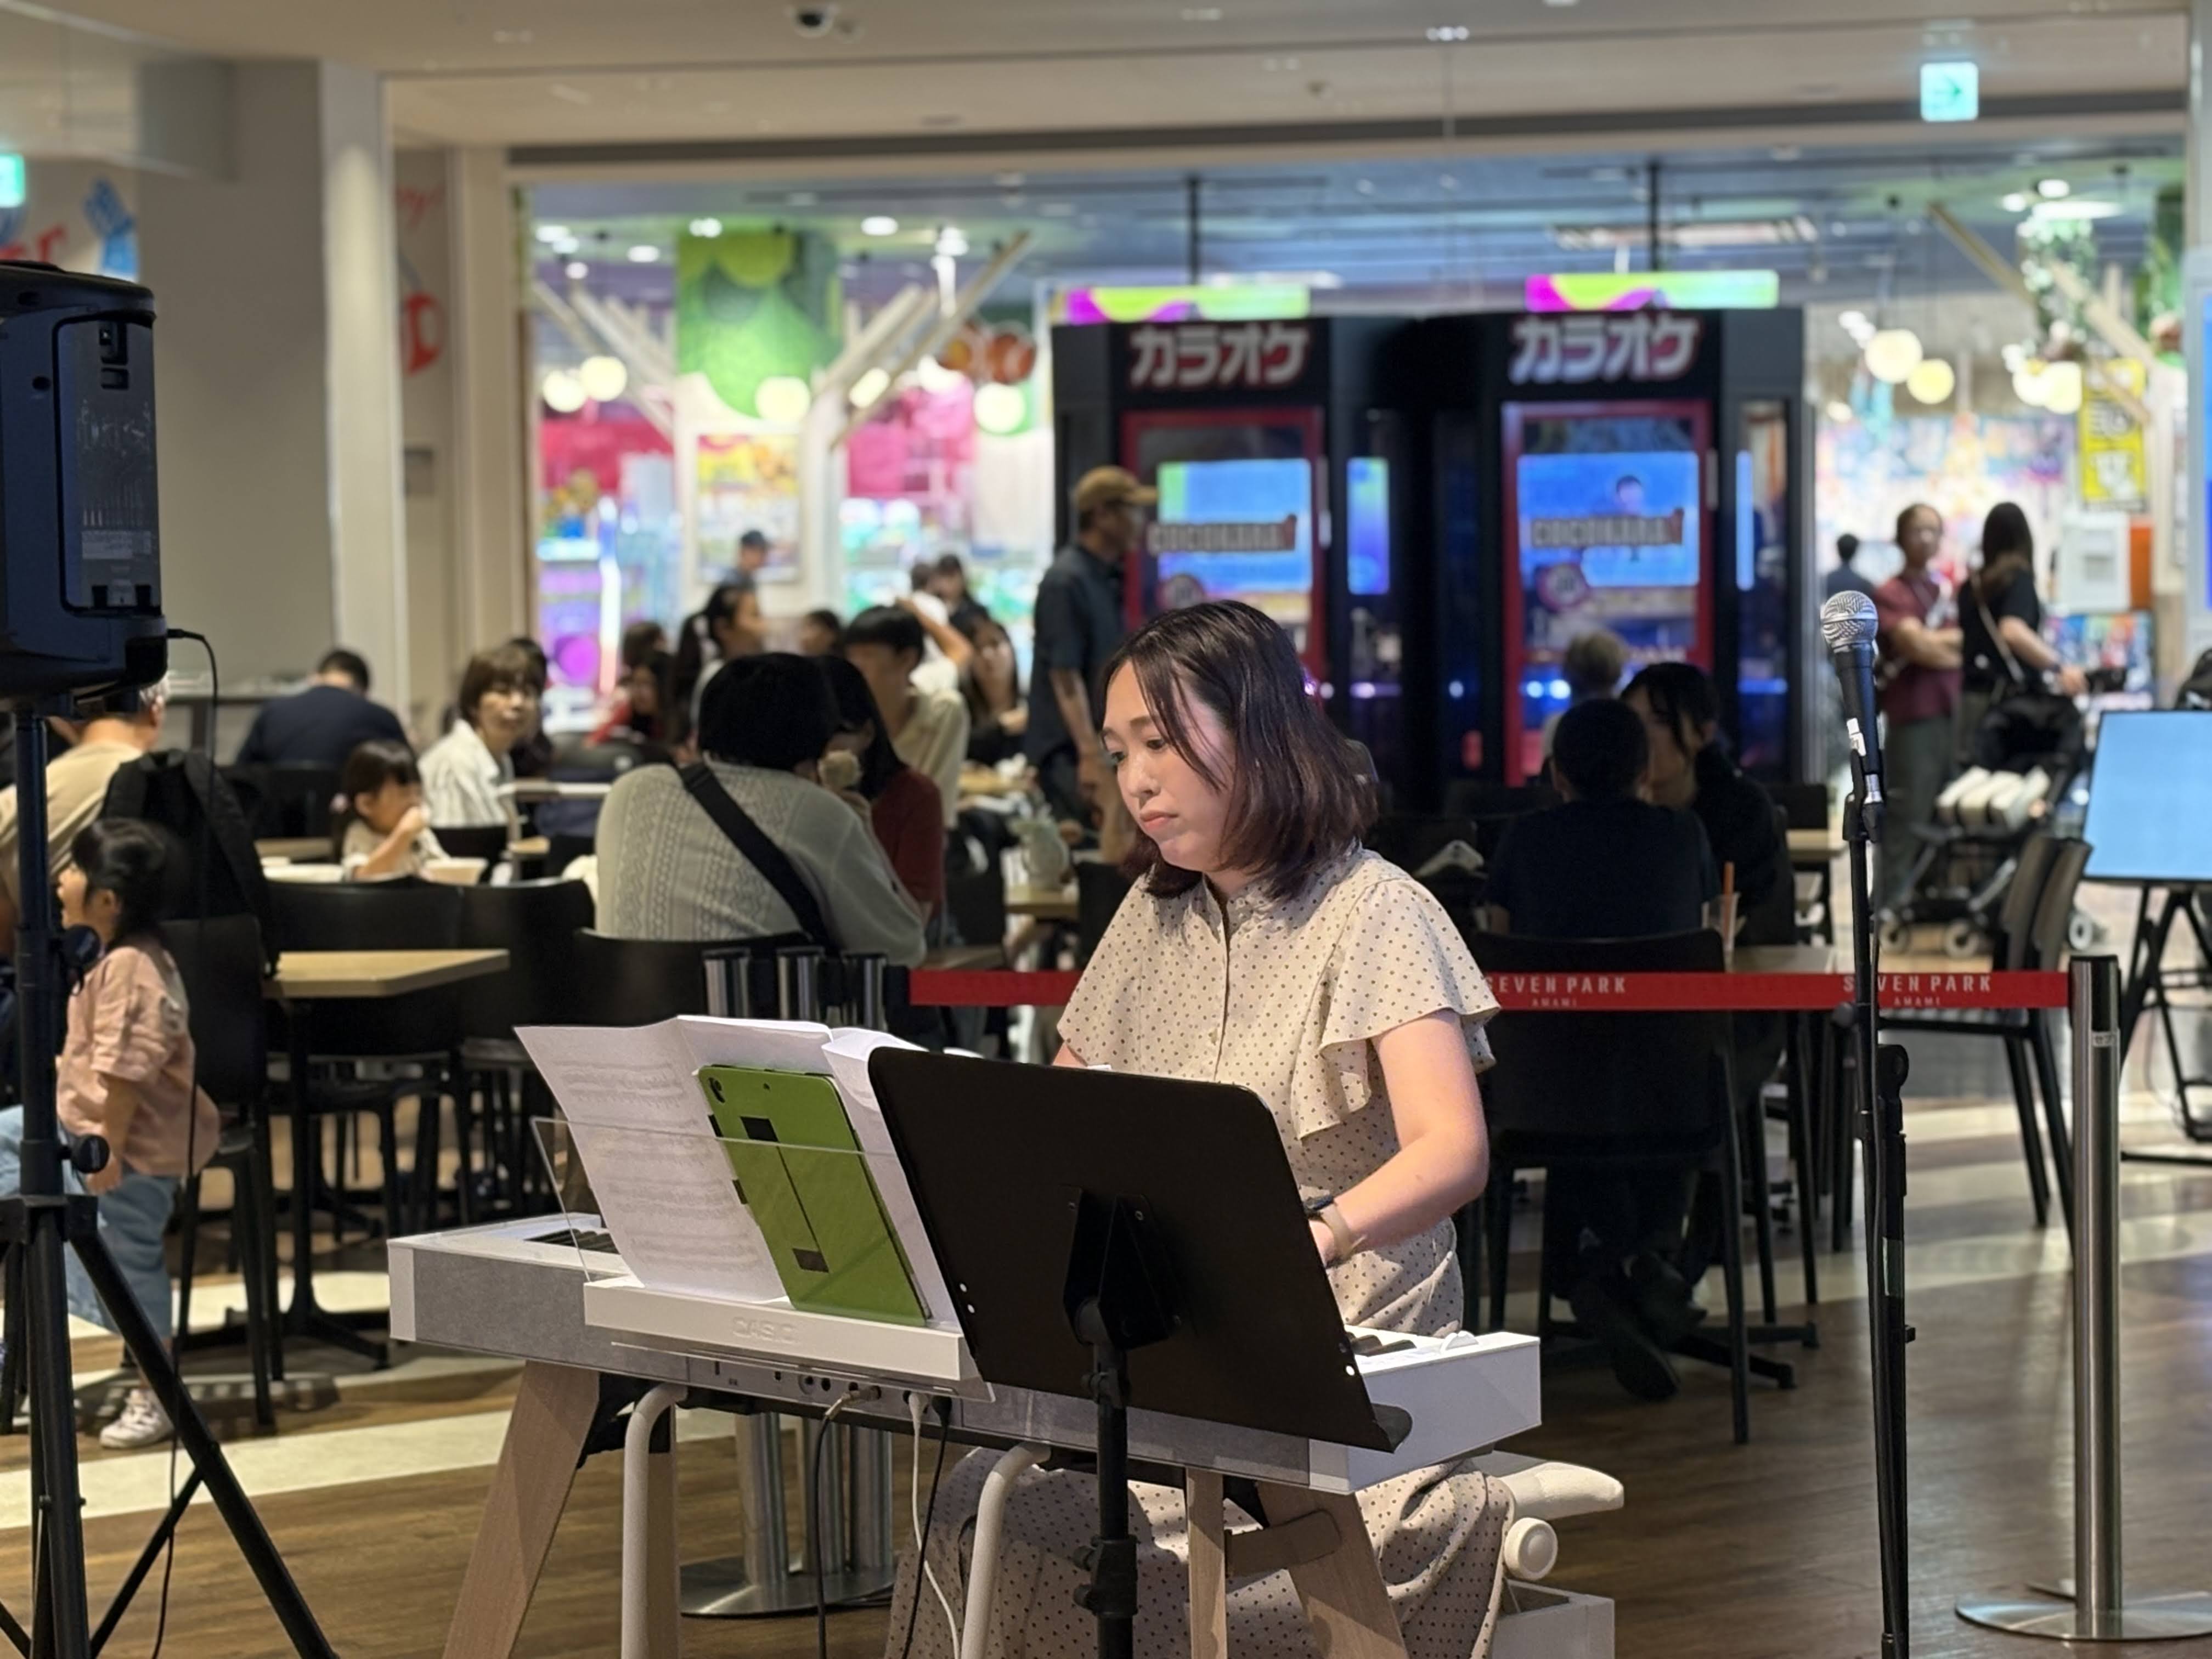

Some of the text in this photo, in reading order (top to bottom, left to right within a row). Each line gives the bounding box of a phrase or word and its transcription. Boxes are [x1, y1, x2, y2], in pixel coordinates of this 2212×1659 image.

[1129, 324, 1309, 385] カラオケ
[1510, 312, 1699, 383] カラオケ
[1567, 976, 1626, 994] PARK
[1843, 975, 1991, 992] SVEN PARK
[1531, 998, 1578, 1007] AMAMI
[1893, 996, 1940, 1006] AMAMI
